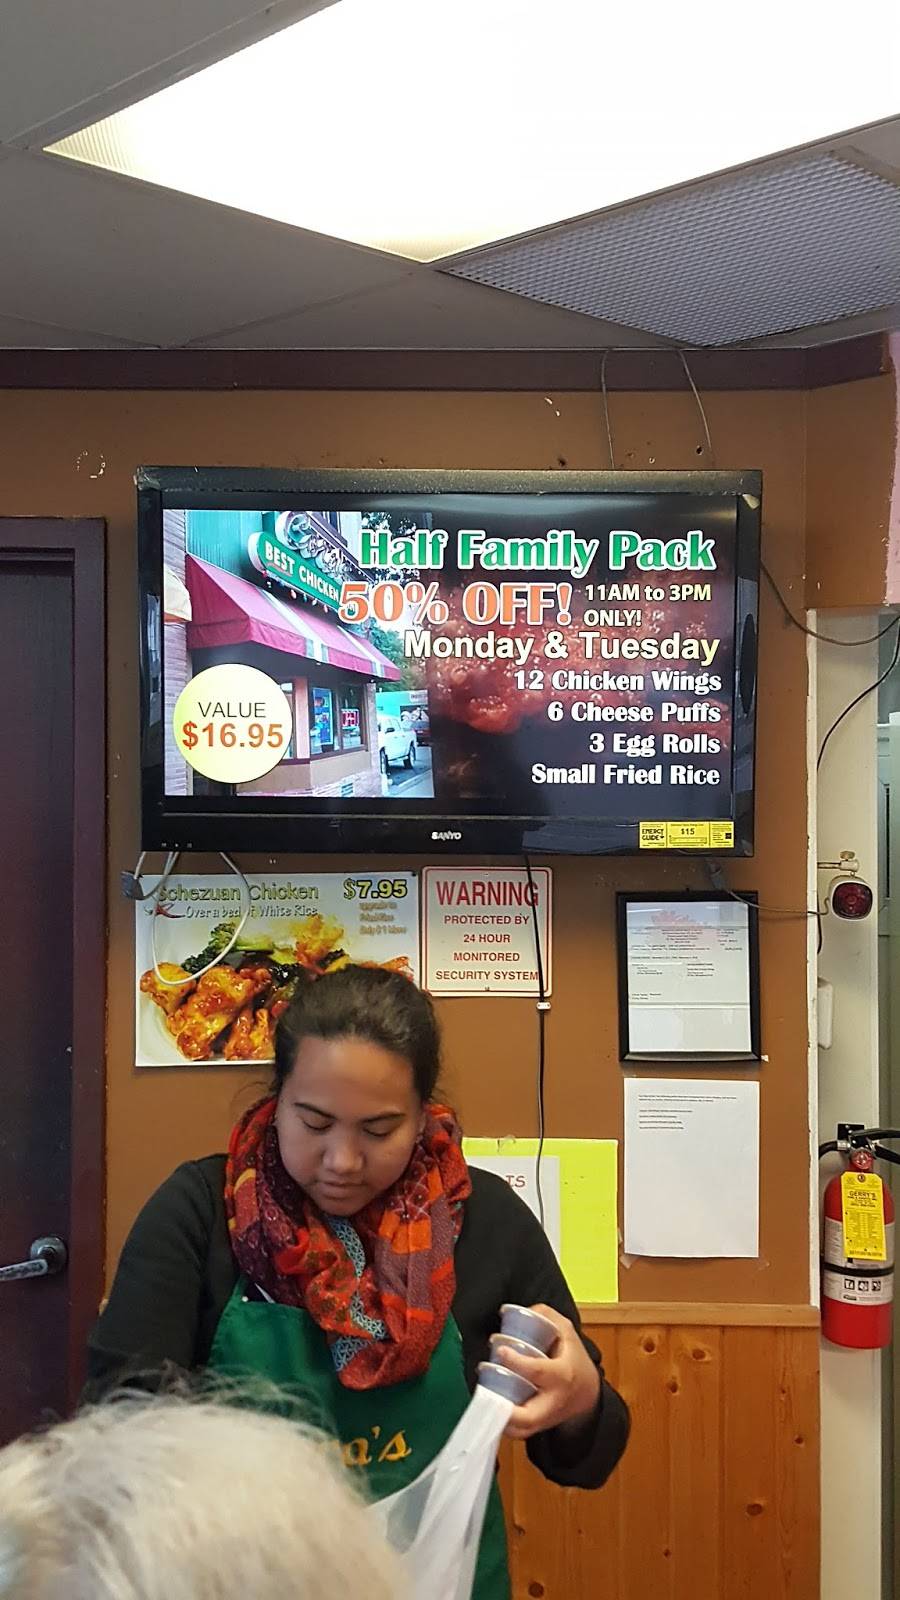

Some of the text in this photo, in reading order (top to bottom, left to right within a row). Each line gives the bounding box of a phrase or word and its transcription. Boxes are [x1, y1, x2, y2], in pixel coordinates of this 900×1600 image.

[360, 530, 717, 578] Half Family Pack
[265, 541, 339, 602] BEST CHICKEN
[585, 584, 712, 601] 11AM to 3PM
[339, 581, 573, 626] 50% OFF!
[583, 610, 642, 627] ONLY!
[404, 630, 721, 666] Monday & Tuesday
[514, 670, 722, 695] 12 Chicken Wings
[198, 702, 267, 718] VALUE
[547, 702, 722, 723] 6 Cheese Puffs
[182, 721, 284, 750] $16.95
[589, 733, 721, 757] 3 Egg Rolls
[531, 763, 720, 785] Small Fried Rice
[431, 830, 462, 840] SANYO
[249, 882, 319, 901] Chicken
[343, 878, 408, 900] $7.95
[436, 881, 539, 906] WARNING
[186, 905, 212, 918] Over
[222, 904, 241, 918] bed
[259, 905, 292, 917] White
[294, 905, 318, 917] Rice
[444, 915, 530, 924] PROTECTED BY
[463, 934, 511, 943] 24 HOUR
[453, 952, 520, 961] MONITORED
[436, 971, 539, 980] SECURITY SYSTEM
